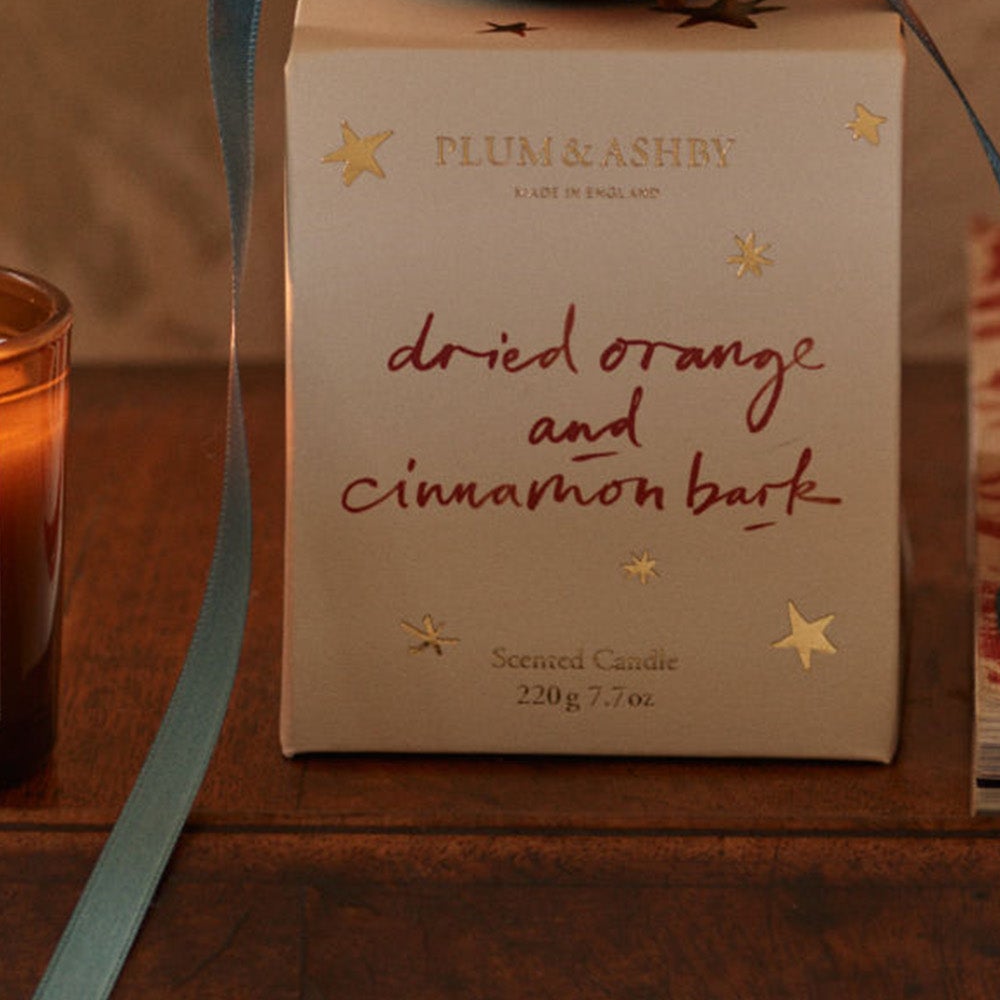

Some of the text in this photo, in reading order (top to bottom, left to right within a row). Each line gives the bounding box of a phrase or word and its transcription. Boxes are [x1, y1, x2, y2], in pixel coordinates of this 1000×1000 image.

[436, 135, 736, 168] PLUM & ASHBY
[387, 303, 825, 433] dried orange
[528, 386, 643, 449] and
[341, 447, 842, 516] cinnamon bark
[491, 647, 679, 671] Scented Candle
